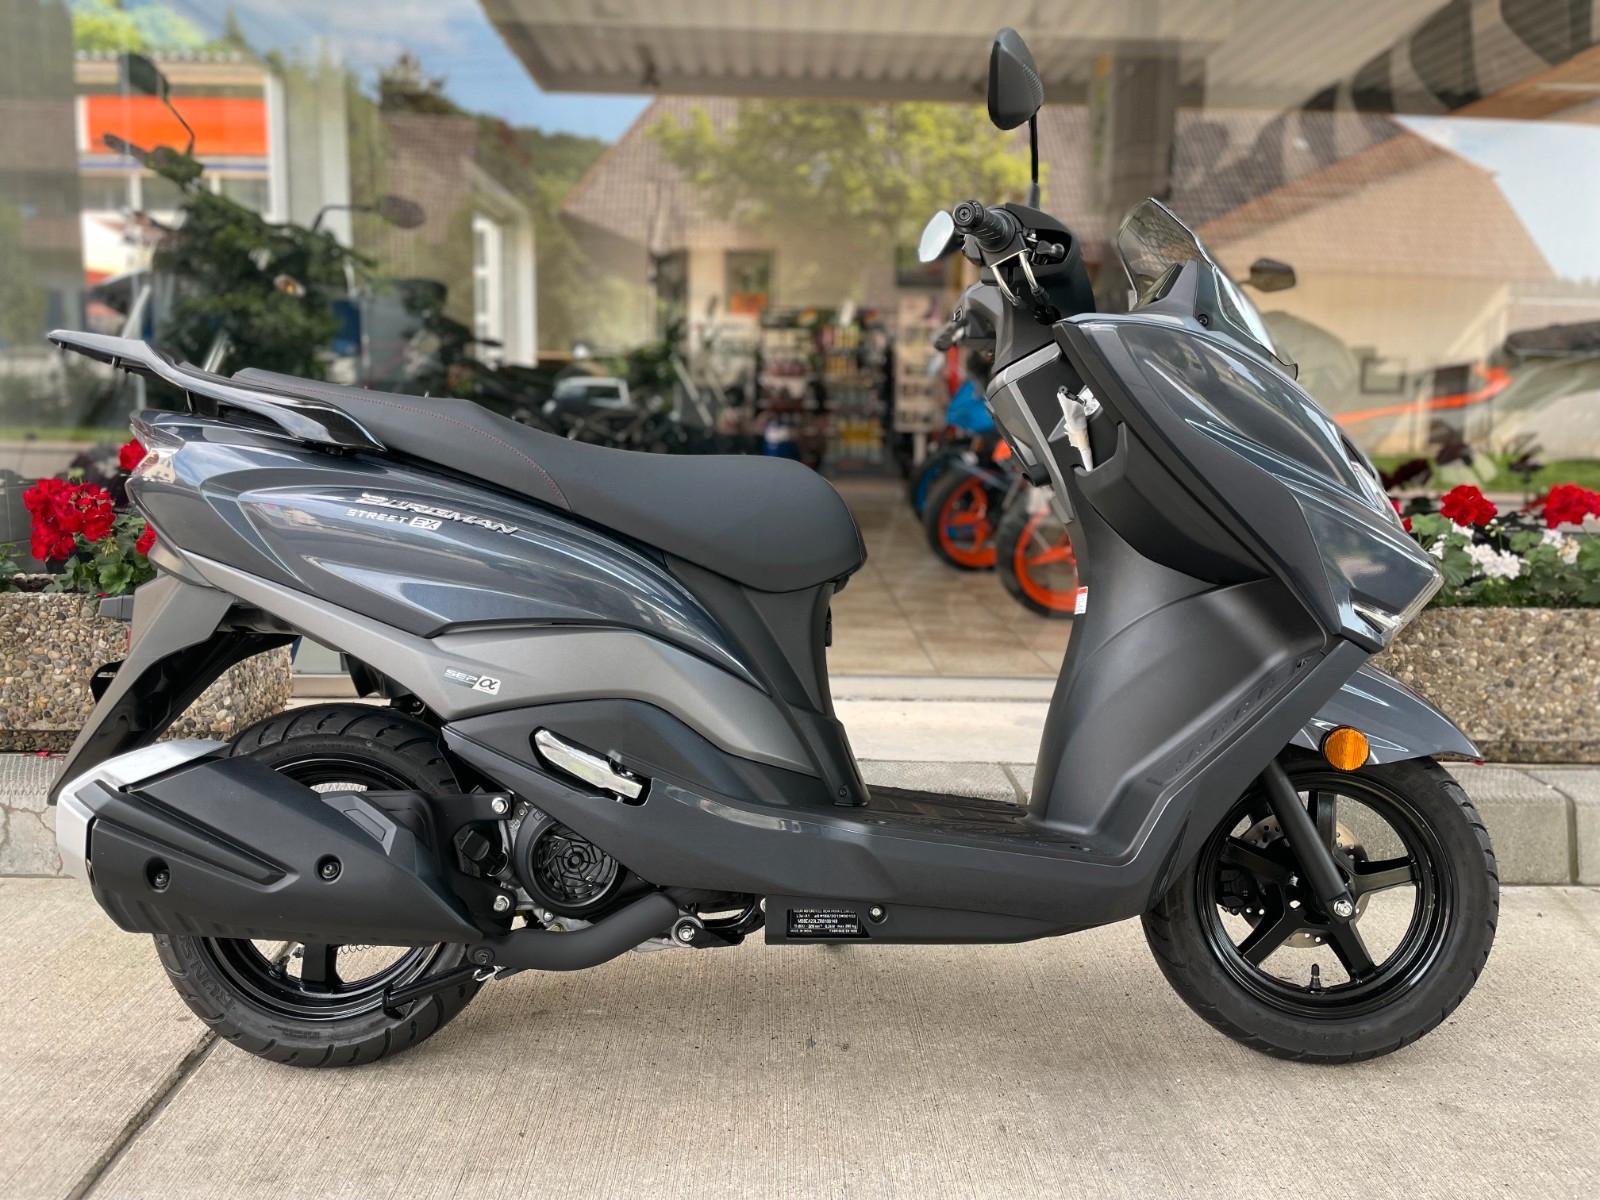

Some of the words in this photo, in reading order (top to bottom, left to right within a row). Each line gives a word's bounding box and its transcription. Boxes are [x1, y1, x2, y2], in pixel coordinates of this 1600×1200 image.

[345, 508, 409, 524] STREET
[411, 517, 441, 531] EX
[355, 493, 519, 535] BURGMAN
